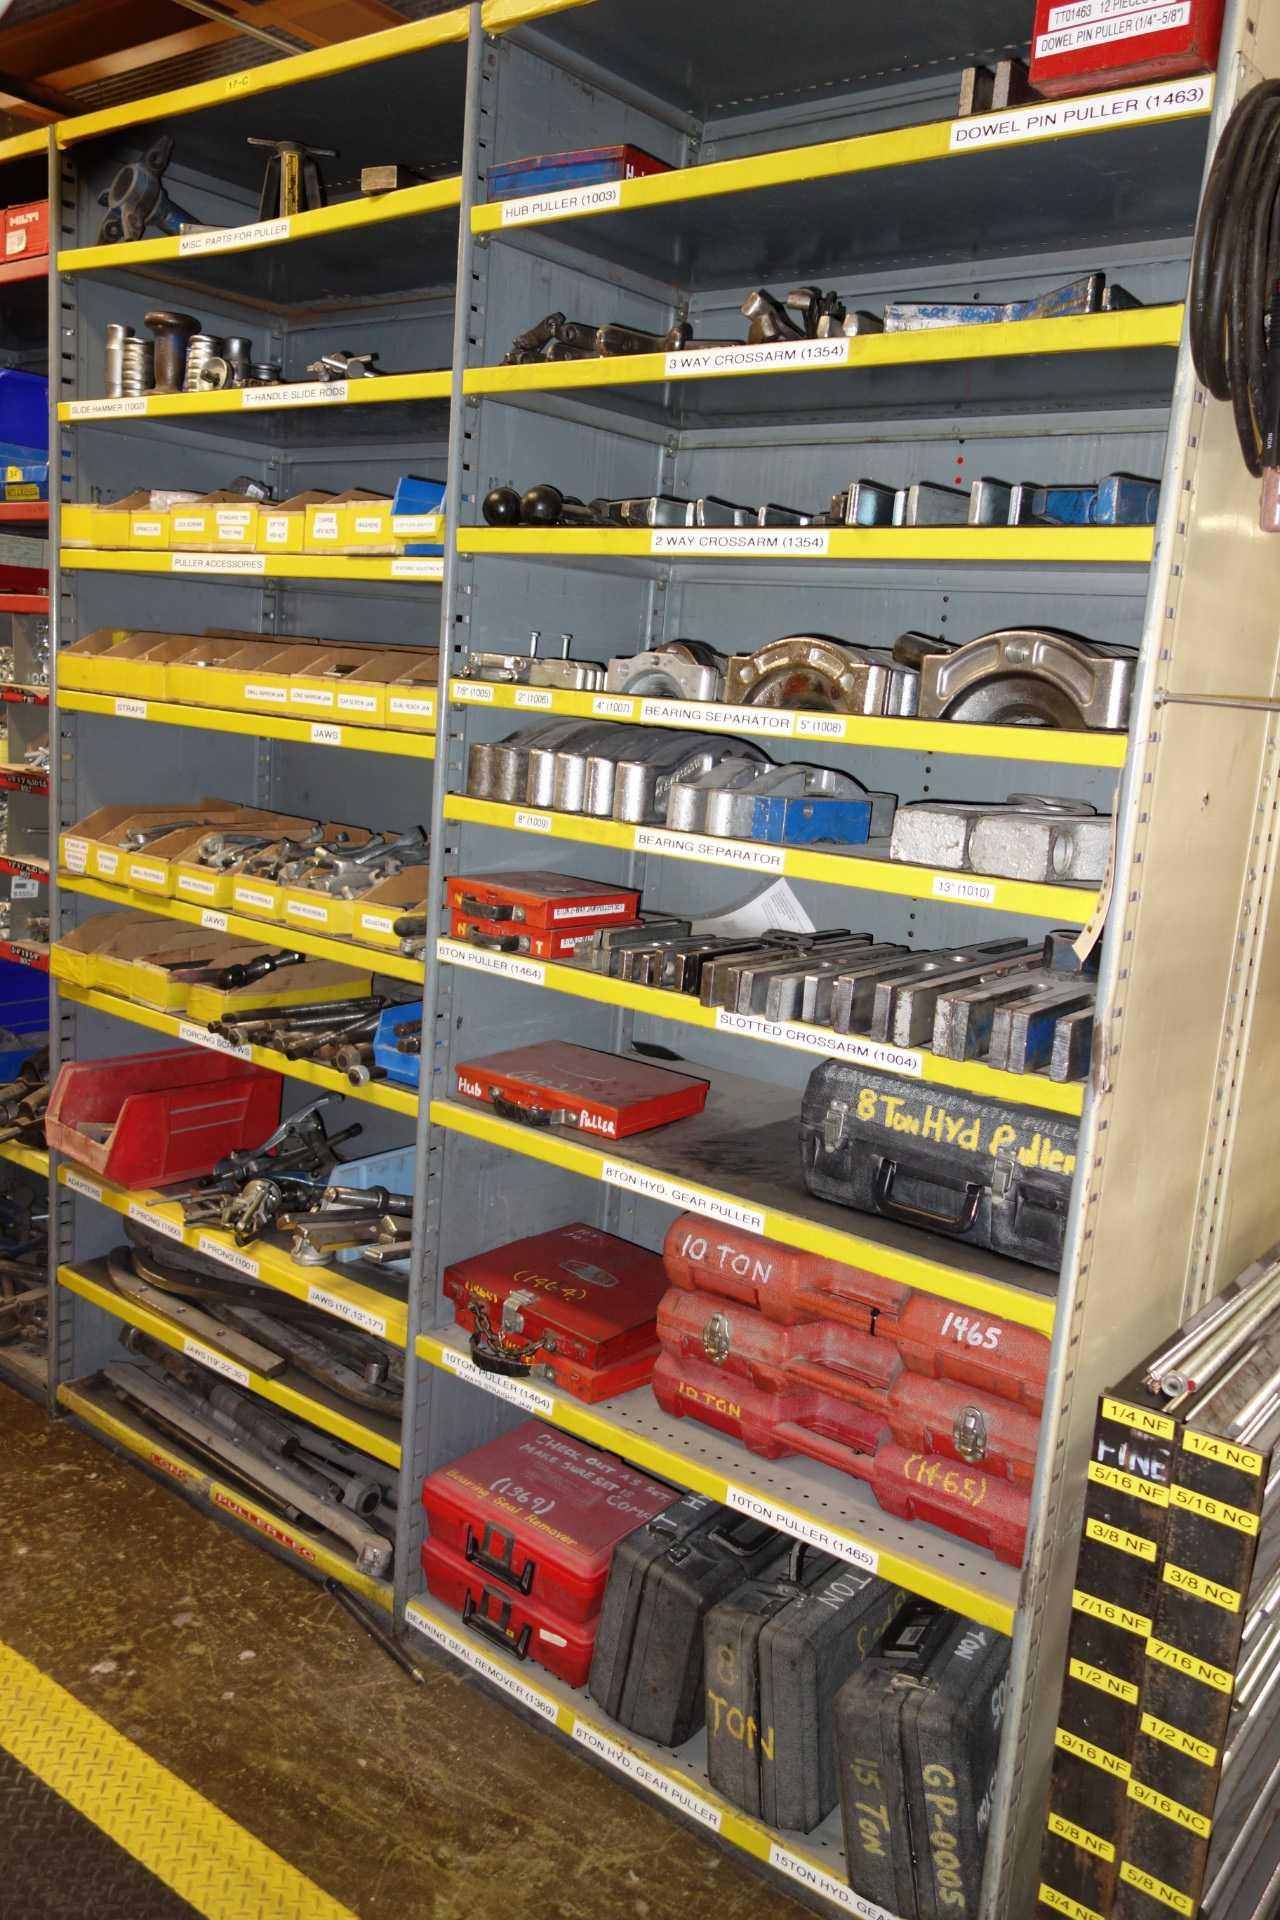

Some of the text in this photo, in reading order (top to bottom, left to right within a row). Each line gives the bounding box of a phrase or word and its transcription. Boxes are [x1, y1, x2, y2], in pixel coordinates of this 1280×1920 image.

[1055, 2, 1110, 25] TT01463 12
[1041, 34, 1074, 52] DOWEL
[1077, 29, 1092, 43] PIN
[1095, 19, 1132, 38] PULLER
[956, 86, 1205, 142] DOWEL PIN PULLER (1463)
[505, 189, 617, 218] HUB PULLER (1003)
[205, 234, 232, 246] PARTS
[234, 229, 252, 240] FOR
[254, 224, 287, 238] PULLER
[669, 344, 844, 369] 3 WAY CROSSARM (1354)
[71, 404, 92, 414] SLIDE
[93, 403, 123, 413] HAMMER
[245, 386, 345, 402] T-HANDLE SLIDE RODS
[655, 536, 824, 548] 2 WAY CROSSARM (1354)
[175, 558, 263, 569] PULLER ACCESSORIES
[470, 687, 491, 699] (1005)
[528, 693, 549, 705] (1006)
[606, 702, 630, 713] (1007)
[117, 703, 145, 715] STRAPS
[645, 705, 790, 728] BEARING SEPARATOR
[313, 730, 339, 740] JAWS
[813, 720, 842, 733] (1008)
[526, 816, 549, 829] (1009)
[638, 834, 781, 866] BEARING SEPARATOR
[957, 883, 990, 899] (1010)
[204, 916, 225, 927] JAWS
[468, 953, 508, 970] PULLER
[511, 964, 542, 980] (1464)
[182, 1028, 215, 1045] FORCING
[720, 1014, 918, 1069] SLOTTED CROSSARM (1004)
[458, 1077, 482, 1097] Hub
[857, 1088, 876, 1120] 8
[605, 1167, 761, 1228] 8TON HYD. GEAR PULLER
[136, 1209, 160, 1227] PRONG
[207, 1242, 234, 1261] PRONG
[234, 1255, 257, 1273] (1001)
[681, 1234, 772, 1283] 10 TON
[311, 1291, 334, 1308] JAWS
[941, 1311, 1002, 1349] 1465
[478, 1369, 518, 1393] PULLER
[520, 1386, 550, 1409] (1464)
[703, 1393, 741, 1419] TON
[1111, 1404, 1169, 1431] 1/4 NF
[519, 1443, 557, 1464] MAKE
[585, 1457, 616, 1474] OUT
[1193, 1438, 1256, 1469] 1/4 NC
[490, 1477, 556, 1515] (1369)
[1095, 1467, 1165, 1501] 5/16 NF
[1176, 1489, 1252, 1528] 5/16 NC
[525, 1512, 579, 1546] Remover
[731, 1493, 773, 1519] 10TON
[776, 1514, 829, 1545] PULLER
[832, 1540, 874, 1566] (1465)
[1092, 1523, 1151, 1553] 3/8 NF
[1170, 1569, 1234, 1605] 3/8 NC
[1080, 1595, 1149, 1631] 7/16 NF
[407, 1611, 556, 1718] BEARING SEAL REMOVER (1369)
[1155, 1643, 1227, 1687] 7/16 NC
[1078, 1666, 1134, 1697] 1/2 NF
[708, 1689, 775, 1761] TON
[1151, 1721, 1209, 1759] 1/2 NC
[1062, 1734, 1128, 1774] 9/16 NF
[608, 1751, 633, 1770] HYD.
[636, 1767, 669, 1793] GEAR
[671, 1790, 718, 1825] PULLER
[1134, 1786, 1206, 1831] 9/16 NC
[1055, 1820, 1111, 1854] 5/8 NF
[775, 1852, 892, 1920] 15TON HYD. GEA
[1044, 1890, 1069, 1911] 3/4
[1127, 1869, 1188, 1909] 5/8 NC
